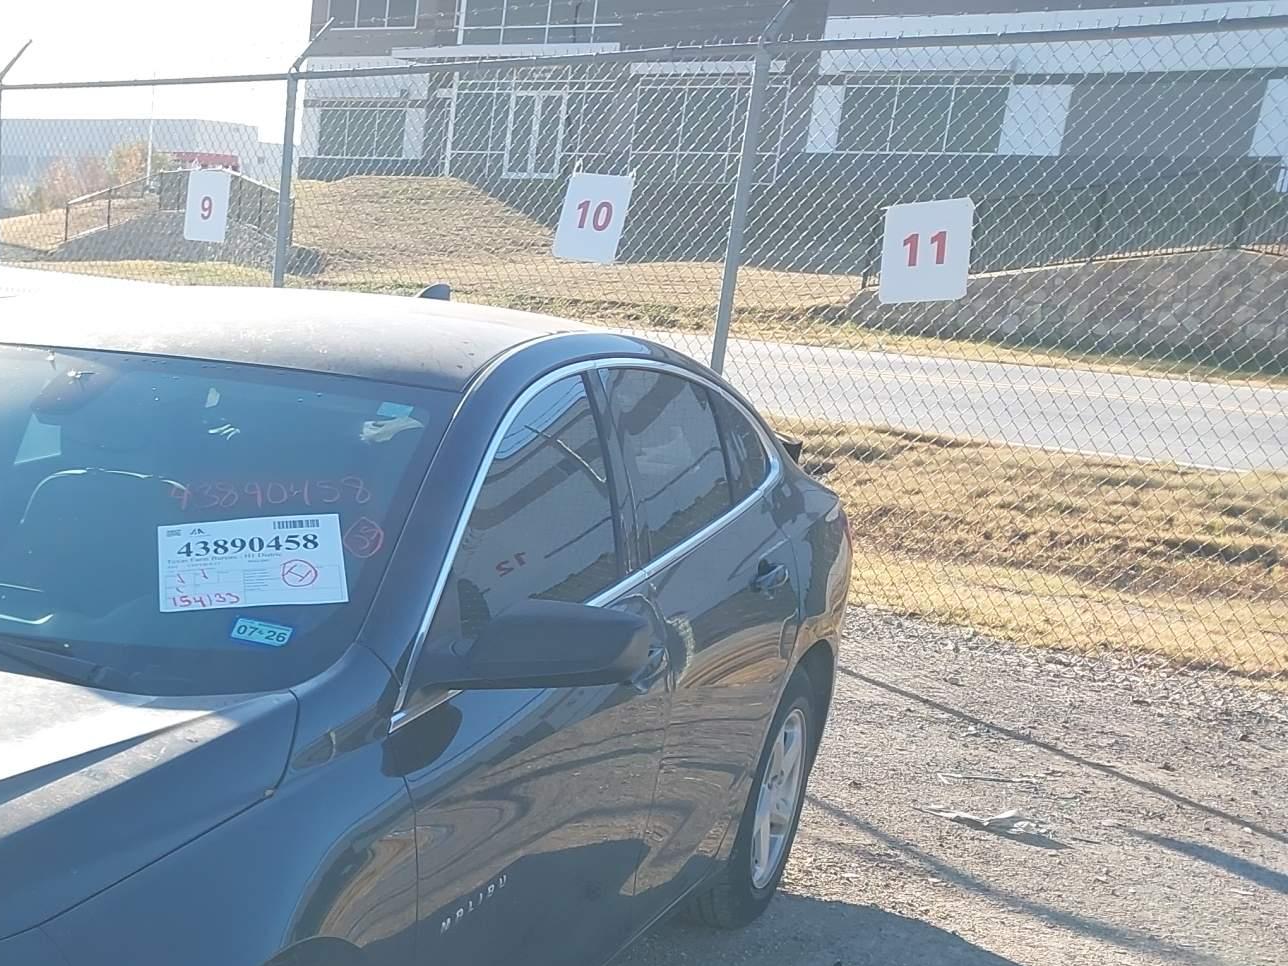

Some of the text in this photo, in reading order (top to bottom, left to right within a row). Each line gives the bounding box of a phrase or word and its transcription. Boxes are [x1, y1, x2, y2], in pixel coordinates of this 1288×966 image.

[199, 195, 213, 220] 9
[575, 199, 613, 232] 10
[902, 230, 948, 267] 11
[170, 476, 371, 510] 43890458
[177, 533, 320, 558] 43890458
[236, 624, 259, 637] 07
[264, 629, 288, 643] 26
